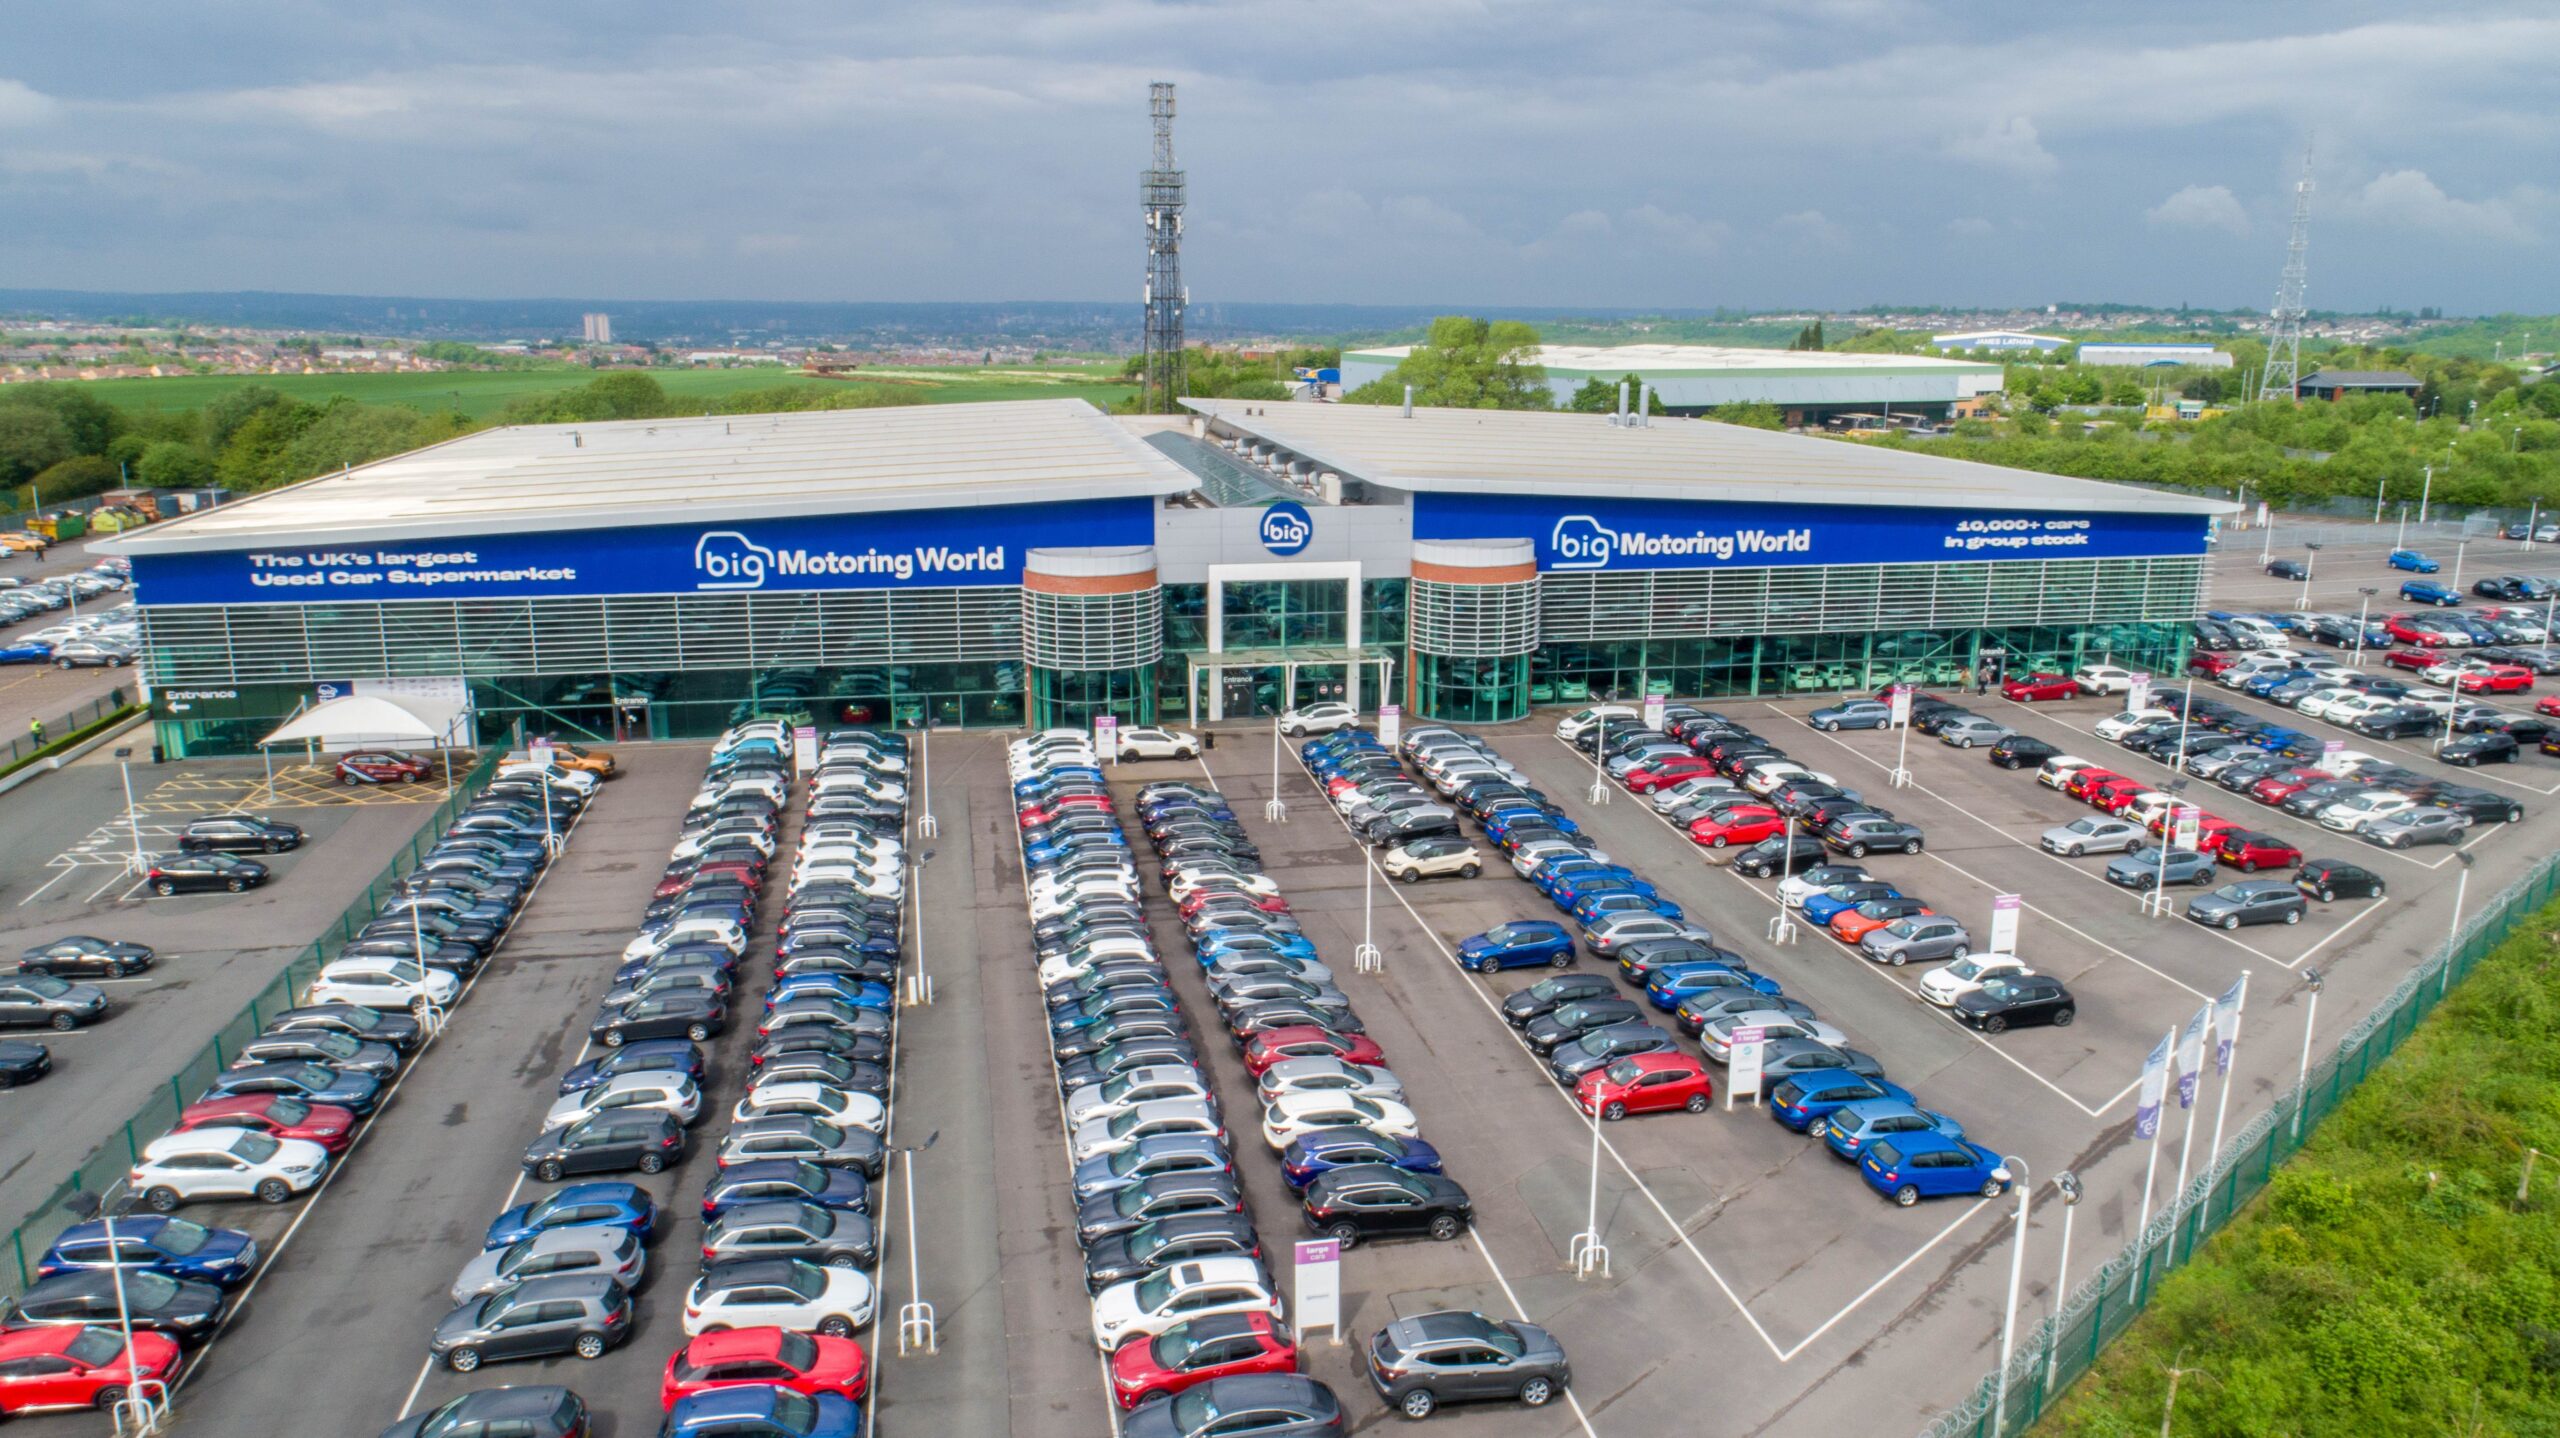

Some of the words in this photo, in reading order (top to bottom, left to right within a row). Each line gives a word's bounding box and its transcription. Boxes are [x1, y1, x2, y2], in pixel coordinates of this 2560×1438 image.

[1956, 520, 2041, 533] 10,000+
[2044, 520, 2090, 530] cars
[1264, 524, 1303, 547] big
[1944, 536, 1964, 548] in
[1965, 536, 2029, 549] group
[2031, 533, 2089, 546] stock
[1552, 534, 1609, 569] big
[1620, 532, 1734, 560] Motoring
[1736, 529, 1811, 552] World
[249, 554, 303, 567] The
[308, 552, 372, 566] UK's
[376, 551, 478, 567] largest
[697, 551, 765, 589] big
[777, 549, 913, 580] Motoring
[915, 546, 1005, 572] World
[251, 571, 325, 586] Used
[328, 571, 383, 584] Car
[387, 567, 576, 586] Supermarket
[165, 690, 237, 700] Entrance
[1306, 1246, 1329, 1255] large
